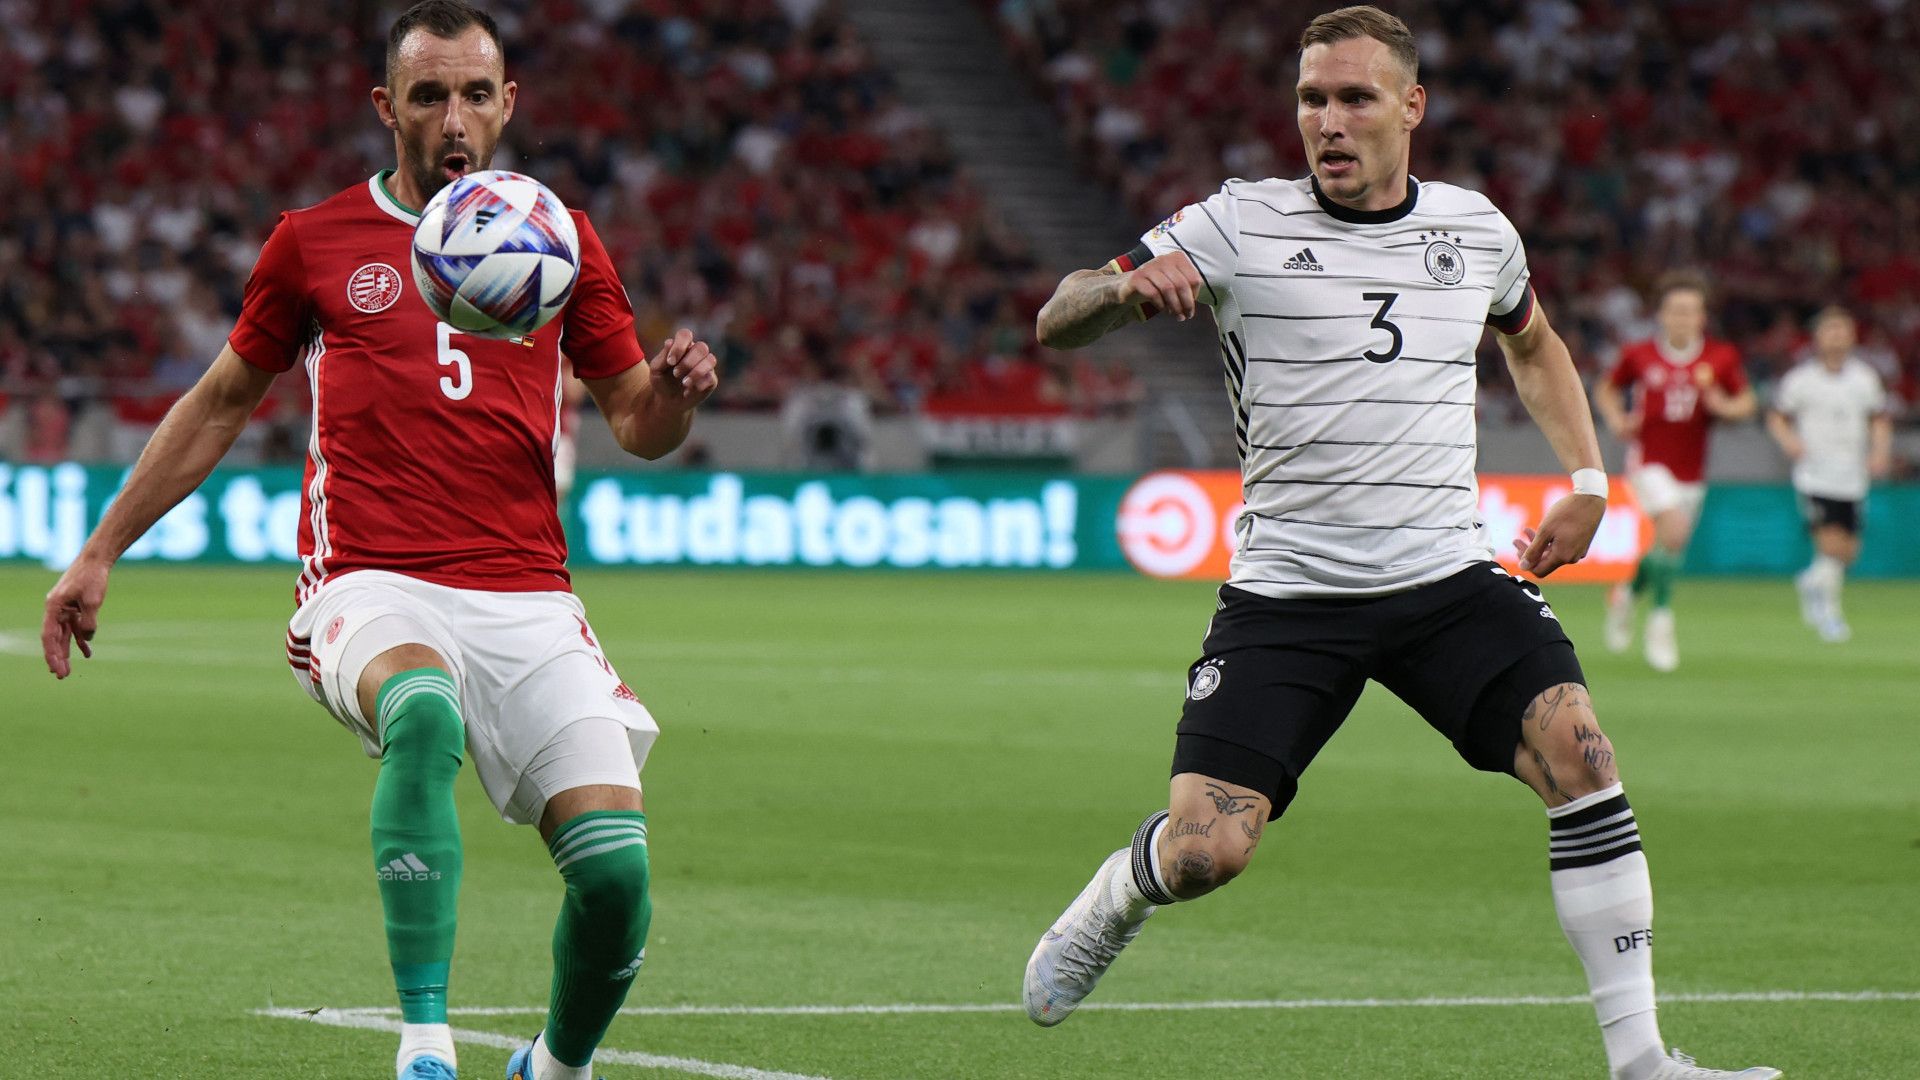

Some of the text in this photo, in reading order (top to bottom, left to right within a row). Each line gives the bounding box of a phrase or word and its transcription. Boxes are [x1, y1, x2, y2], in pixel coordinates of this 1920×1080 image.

[1283, 261, 1324, 271] adidas
[436, 321, 473, 401] 5
[1362, 292, 1404, 364] 3
[580, 472, 1079, 570] tudatosan!
[1583, 744, 1614, 771] NOT
